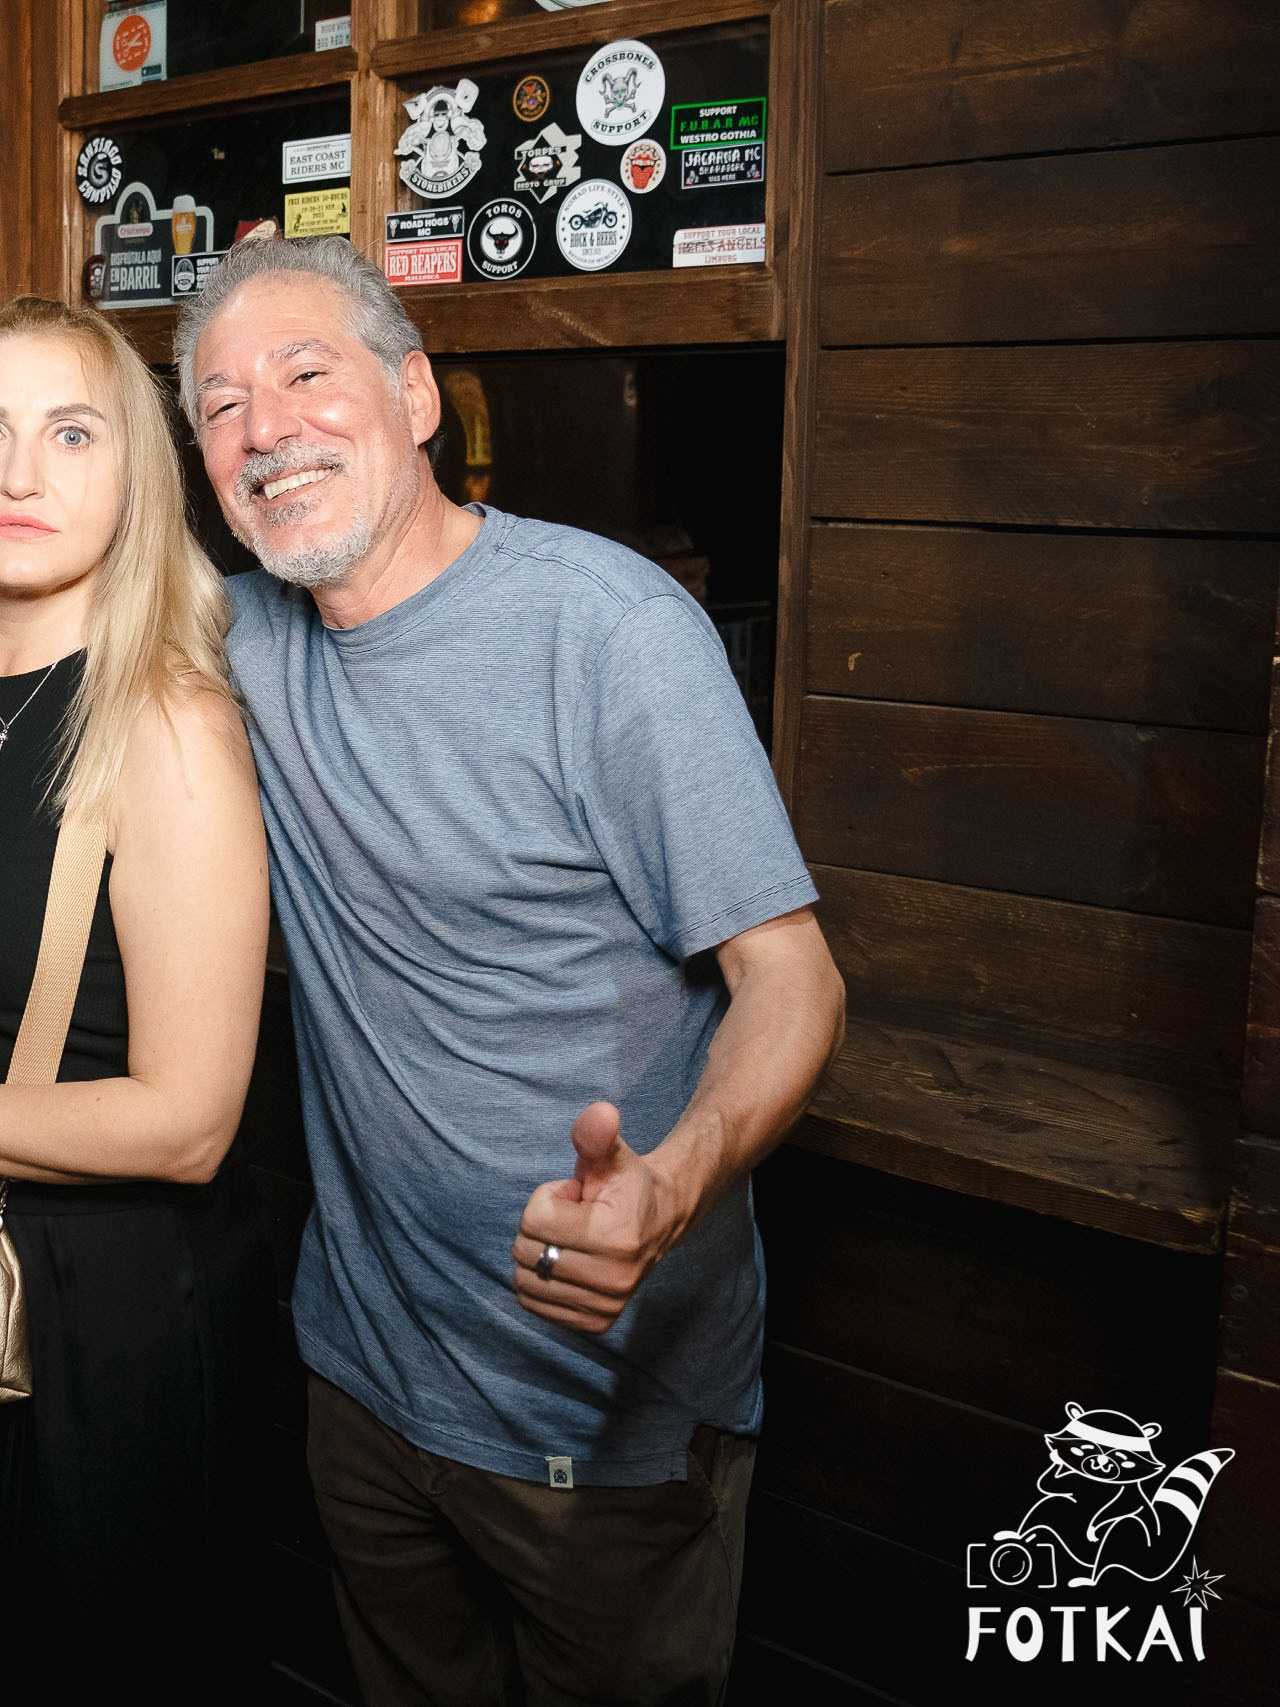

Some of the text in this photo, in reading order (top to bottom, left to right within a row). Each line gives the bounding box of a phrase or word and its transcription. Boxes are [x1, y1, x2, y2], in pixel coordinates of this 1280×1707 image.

[585, 52, 655, 82] CROSSBONES
[699, 105, 738, 117] SUPPORT
[593, 111, 647, 133] SUPPORT
[738, 115, 759, 127] MC
[680, 130, 757, 144] WESTRO GOTHIA
[290, 150, 346, 165] EAST COAST
[744, 146, 761, 162] MC
[291, 161, 345, 175] RIDERS MC
[411, 167, 470, 193] STONEBIKERS
[517, 180, 540, 189] MOTO
[588, 185, 606, 193] LIFE
[607, 188, 625, 208] STYLE
[485, 204, 523, 219] TOROS
[400, 216, 449, 230] ROAD HOGS
[417, 228, 431, 237] MC
[683, 226, 761, 239] SUPPORT YOUR LOCAL
[717, 237, 766, 252] ANGELS
[389, 251, 457, 277] RED REAPERS
[481, 261, 518, 274] SUPPORT
[110, 265, 161, 291] EN BARRIL
